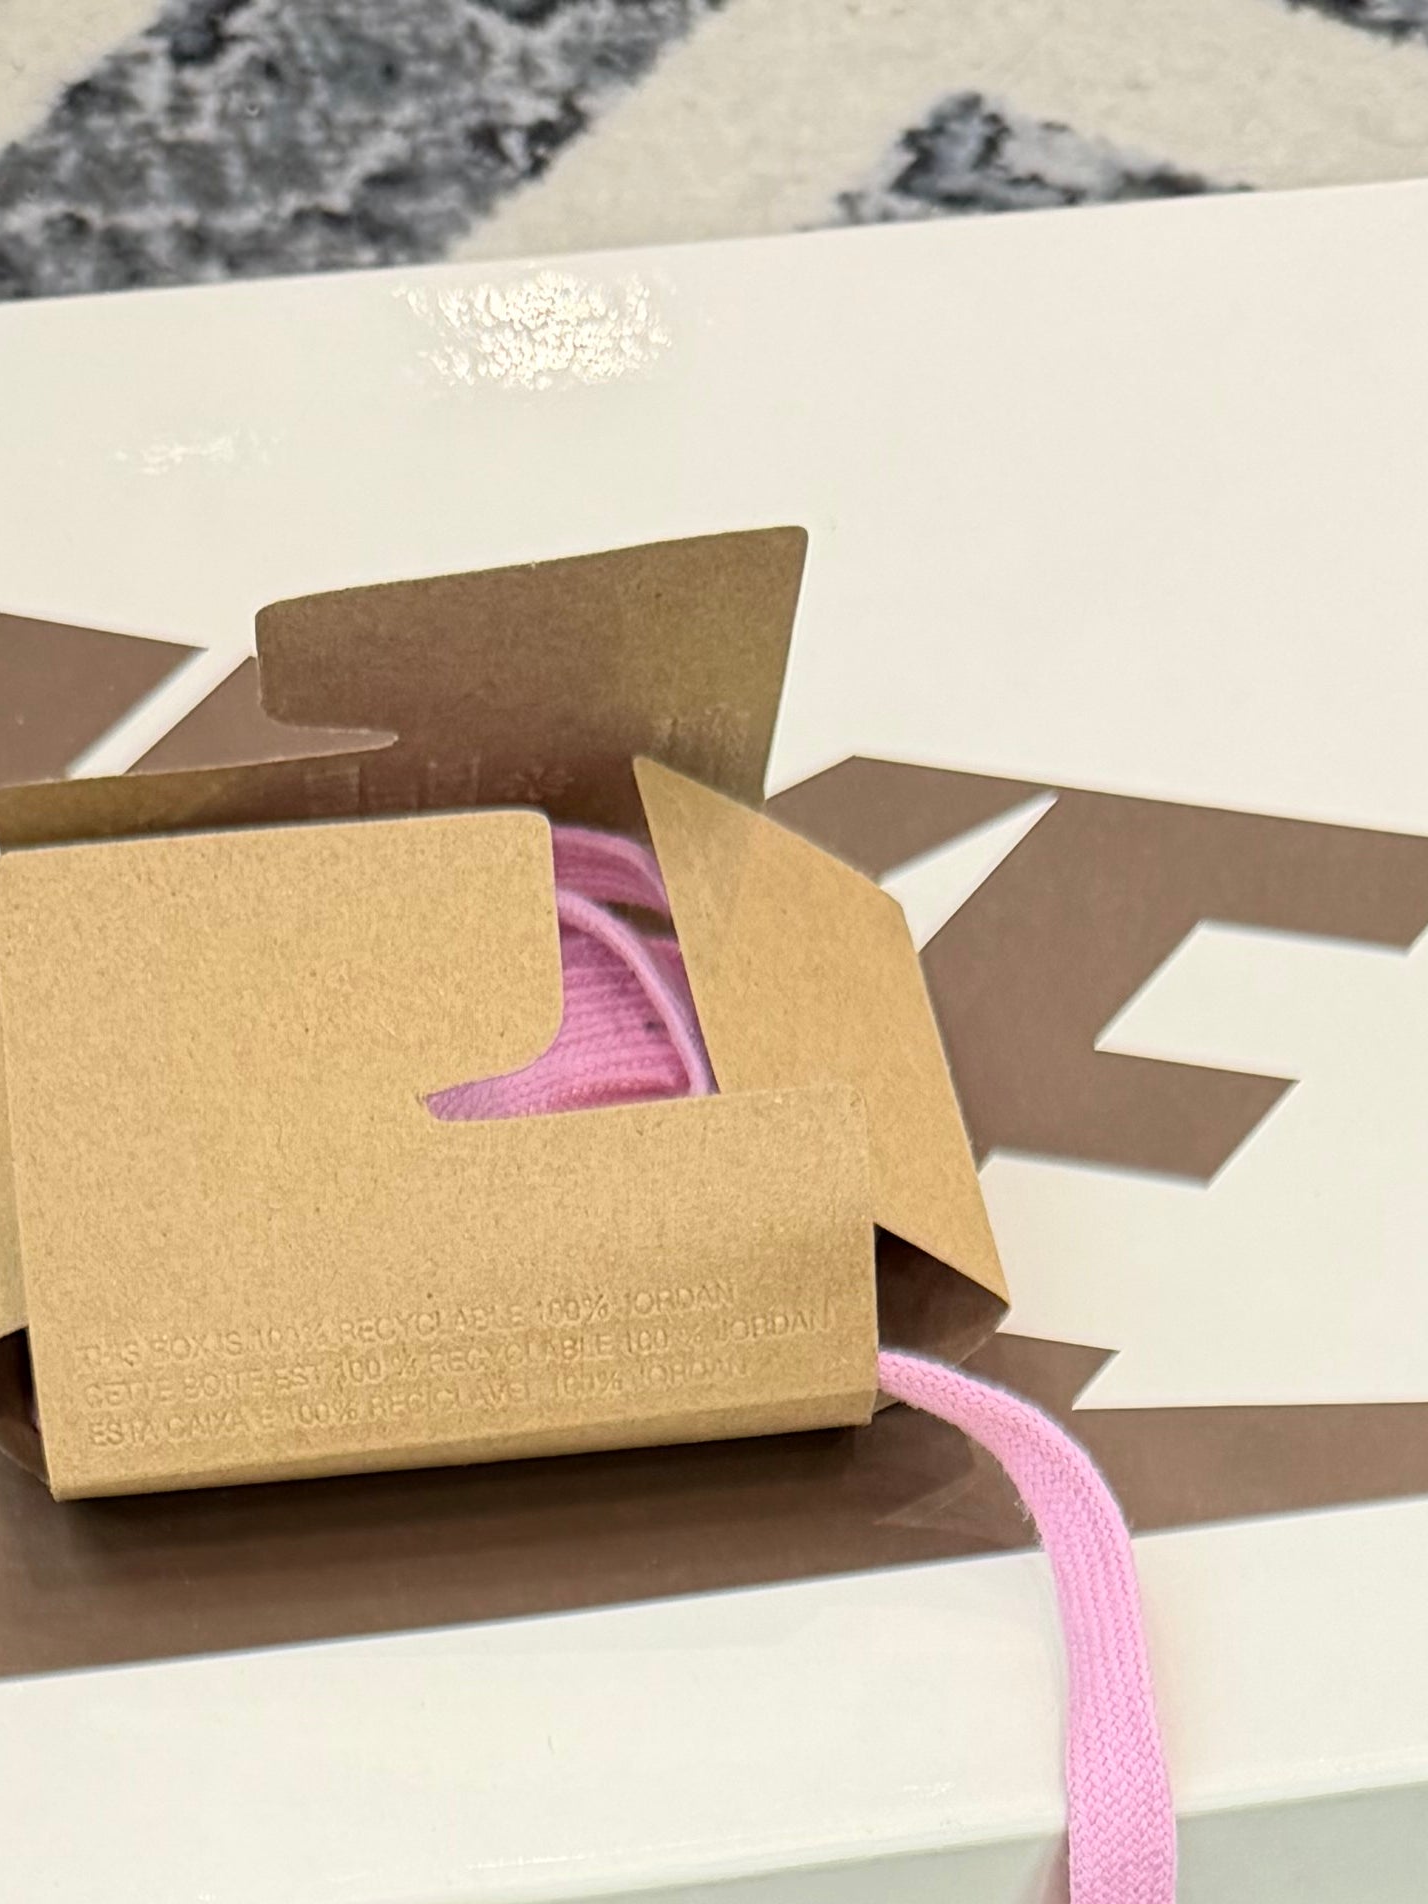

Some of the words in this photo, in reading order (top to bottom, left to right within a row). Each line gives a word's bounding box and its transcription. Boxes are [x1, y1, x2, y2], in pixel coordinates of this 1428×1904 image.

[74, 1338, 141, 1369] THIS
[150, 1333, 214, 1368] BOX
[217, 1329, 243, 1358] IS
[255, 1321, 329, 1351] 100%
[339, 1305, 525, 1344] RECYCLABLE
[537, 1292, 609, 1325] 100%
[623, 1282, 735, 1318] JORDAN
[83, 1376, 178, 1408] CETTE
[274, 1362, 321, 1392] EST
[428, 1333, 614, 1373] RECYCLABLE
[625, 1326, 669, 1356] 100
[714, 1303, 833, 1343] JORDAN
[289, 1400, 359, 1428] 100%
[637, 1356, 749, 1388] JORDAN
